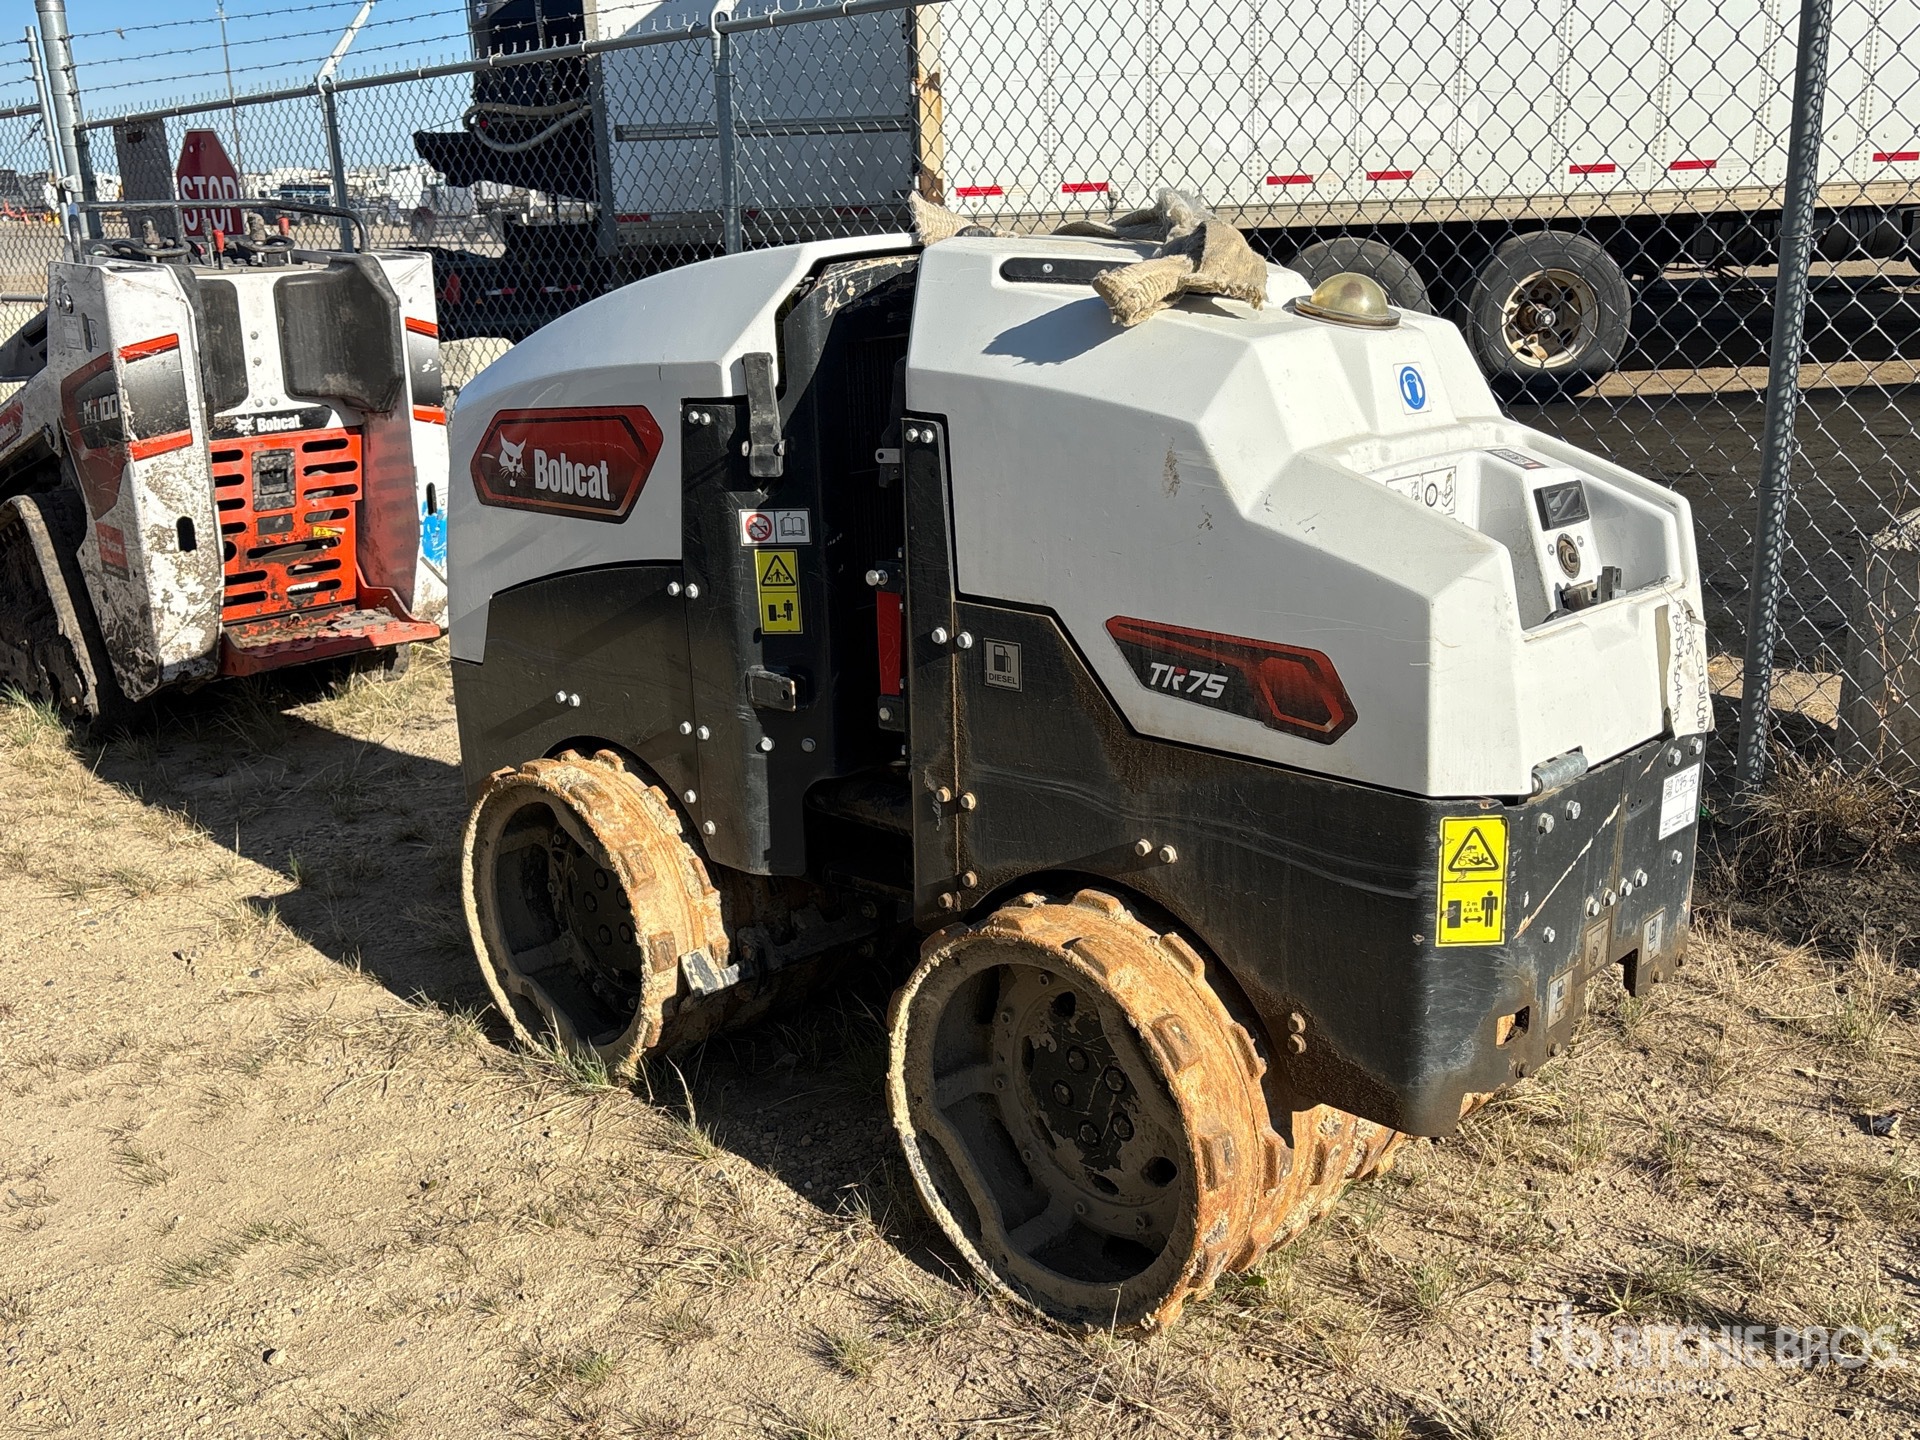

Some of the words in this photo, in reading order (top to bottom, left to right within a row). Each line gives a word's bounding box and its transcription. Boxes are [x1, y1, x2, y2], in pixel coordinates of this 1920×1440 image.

[180, 175, 239, 232] STOP
[256, 415, 302, 432] Bobcat
[534, 449, 611, 502] Bobcat
[988, 673, 1017, 685] DIESEL
[1150, 662, 1228, 699] TR75
